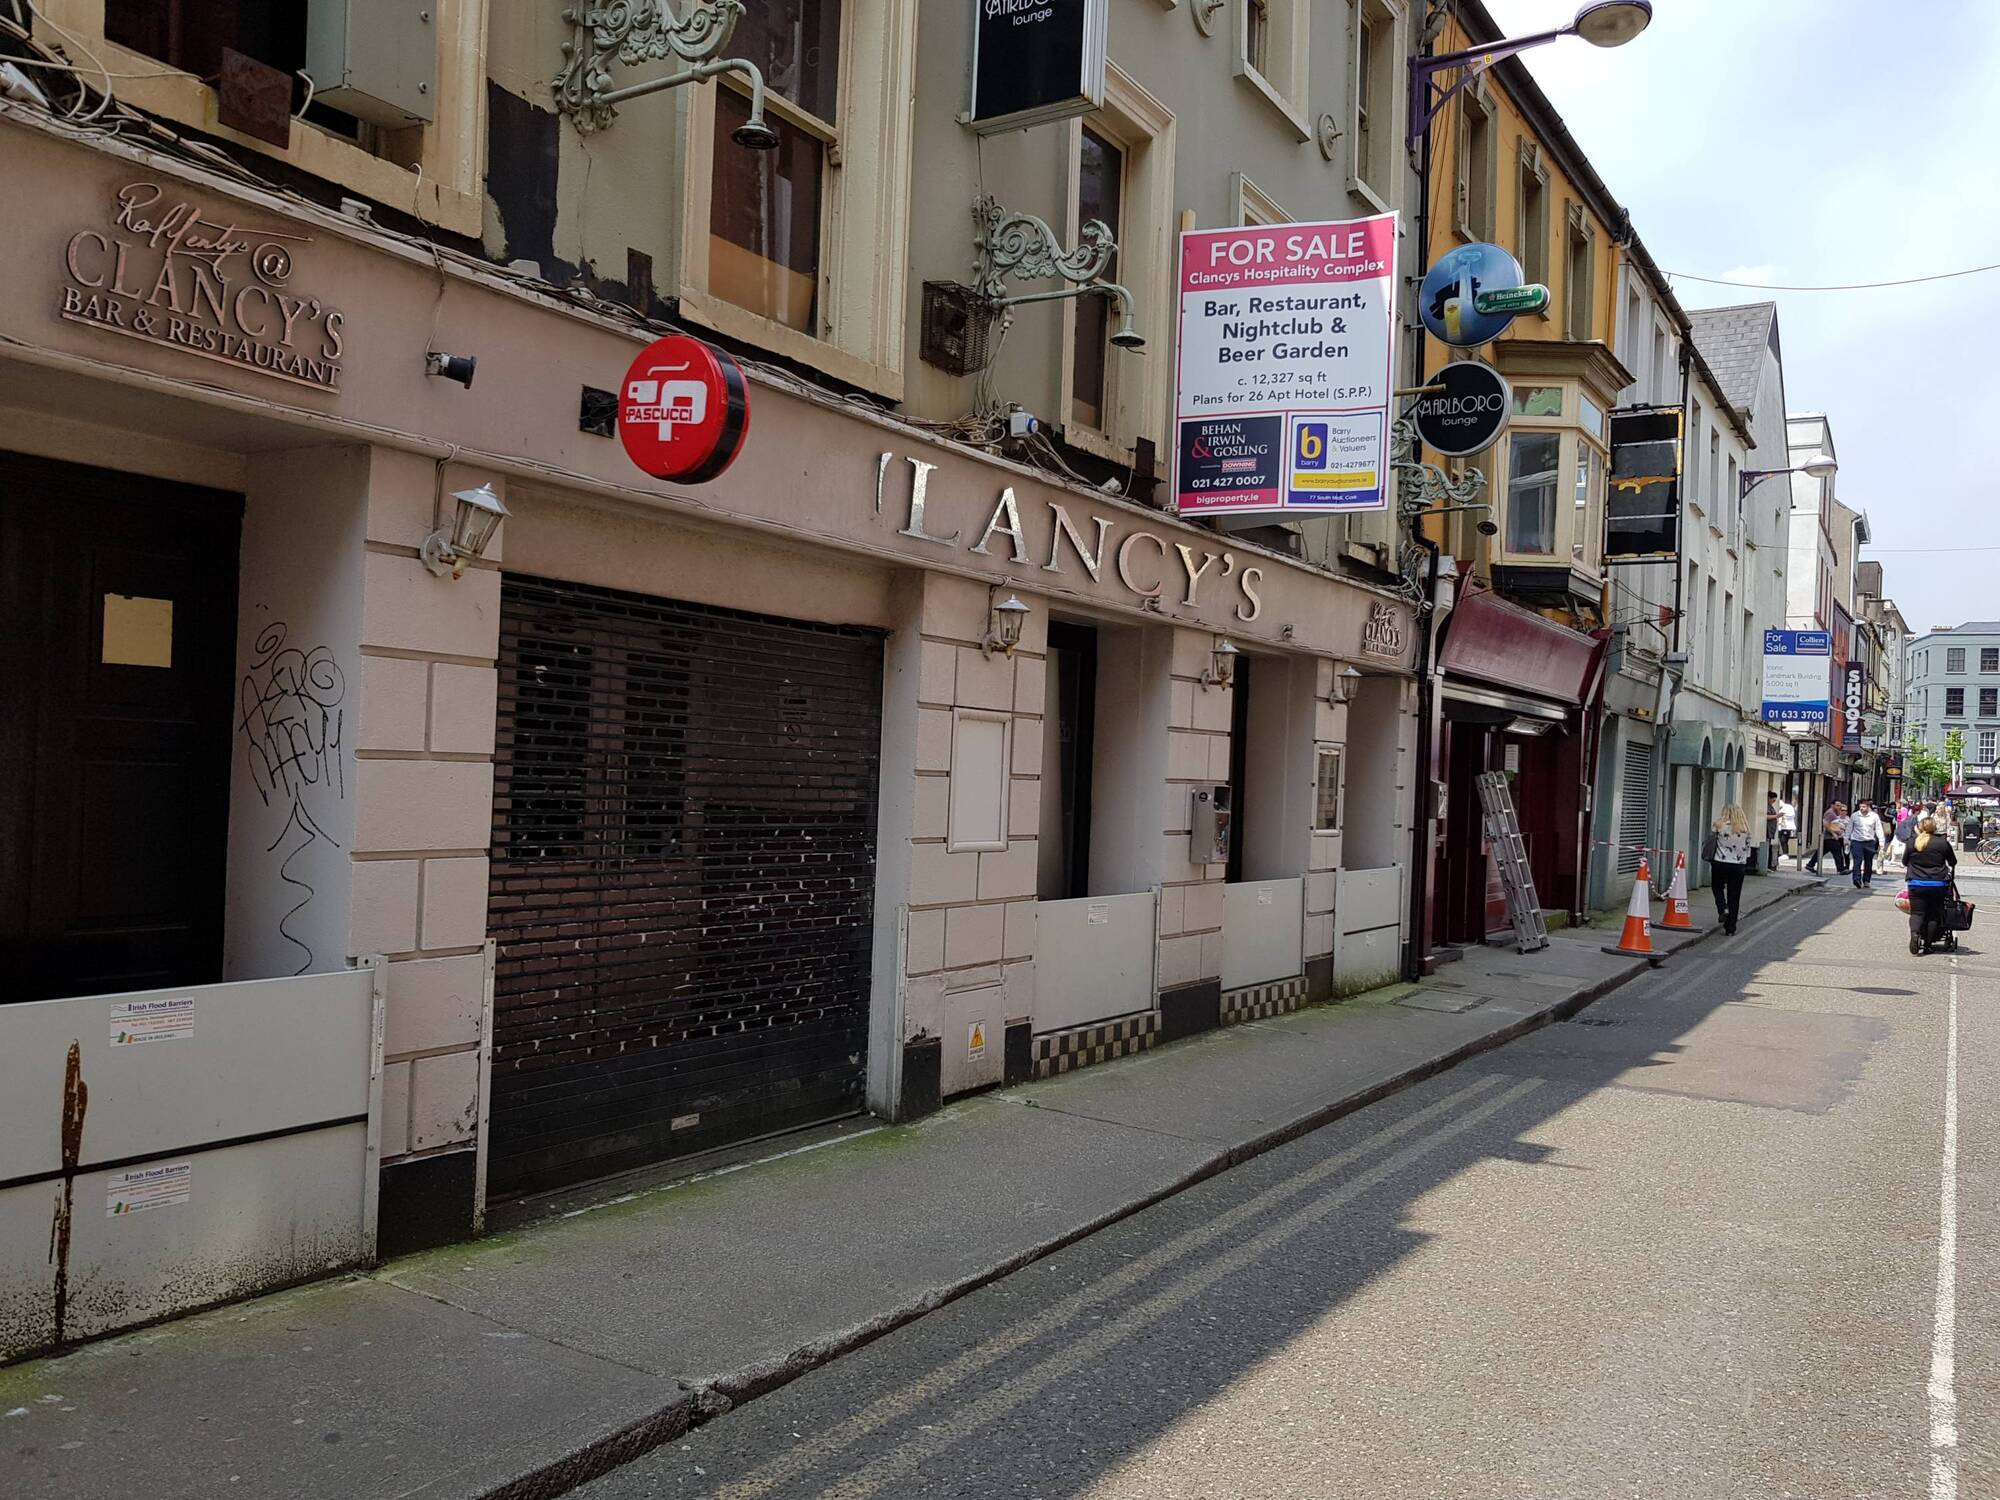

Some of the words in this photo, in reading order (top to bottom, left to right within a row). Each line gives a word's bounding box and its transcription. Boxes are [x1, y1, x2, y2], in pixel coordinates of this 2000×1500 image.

[1013, 8, 1053, 26] lounge
[1210, 238, 1275, 267] FOR
[1286, 231, 1365, 262] SALE
[252, 242, 293, 288] @
[1189, 270, 1240, 285] Clancys
[1244, 264, 1319, 281] Hospitality
[1323, 259, 1384, 277] Complex
[66, 230, 345, 361] CLANCY'S
[1496, 290, 1533, 300] Heineken
[1204, 300, 1241, 318] Bar,
[1249, 293, 1367, 314] Restaurant,
[63, 286, 124, 328] BAR
[133, 308, 157, 336] &
[167, 316, 342, 387] RESTAURANT
[1222, 318, 1323, 343] Nightclub
[1331, 317, 1347, 334] &
[1218, 346, 1266, 364] Beer
[1272, 341, 1349, 360] Garden
[1237, 377, 1247, 386] c.
[1252, 372, 1294, 386] 12,327
[1298, 374, 1313, 384] sq
[1317, 371, 1328, 383] ft
[1193, 395, 1224, 405] Plans
[1227, 393, 1244, 403] for
[1248, 390, 1263, 402] 26
[1267, 389, 1290, 403] Apt
[1295, 388, 1329, 400] Hotel
[1333, 386, 1372, 400] (S.P.P.)
[1417, 393, 1504, 417] MARLBORO
[627, 408, 693, 421] PASCUCCI
[1441, 414, 1478, 426] lounge
[1202, 423, 1241, 436] BEHAN
[1192, 437, 1212, 459] &
[1208, 434, 1246, 447] IRWIN
[1301, 426, 1322, 459] b
[1331, 435, 1377, 444] Auctioneers
[1214, 444, 1268, 457] GOSLING
[1340, 444, 1367, 453] Valuers
[1192, 479, 1210, 488] 021
[1213, 477, 1233, 487] 427
[1236, 475, 1266, 486] 0007
[1196, 493, 1259, 504] bigproperty.ie
[876, 452, 1264, 623] LANCY'S
[1766, 632, 1783, 642] For
[1766, 643, 1787, 652] Sale
[1846, 669, 1861, 734] SHOOZ
[1768, 710, 1779, 718] 01
[1782, 711, 1798, 719] 633
[1801, 711, 1824, 720] 3700
[132, 1003, 147, 1011] Irish
[148, 1001, 167, 1009] Flood
[145, 1169, 163, 1178] Flood
[165, 1165, 189, 1173] Barriers
